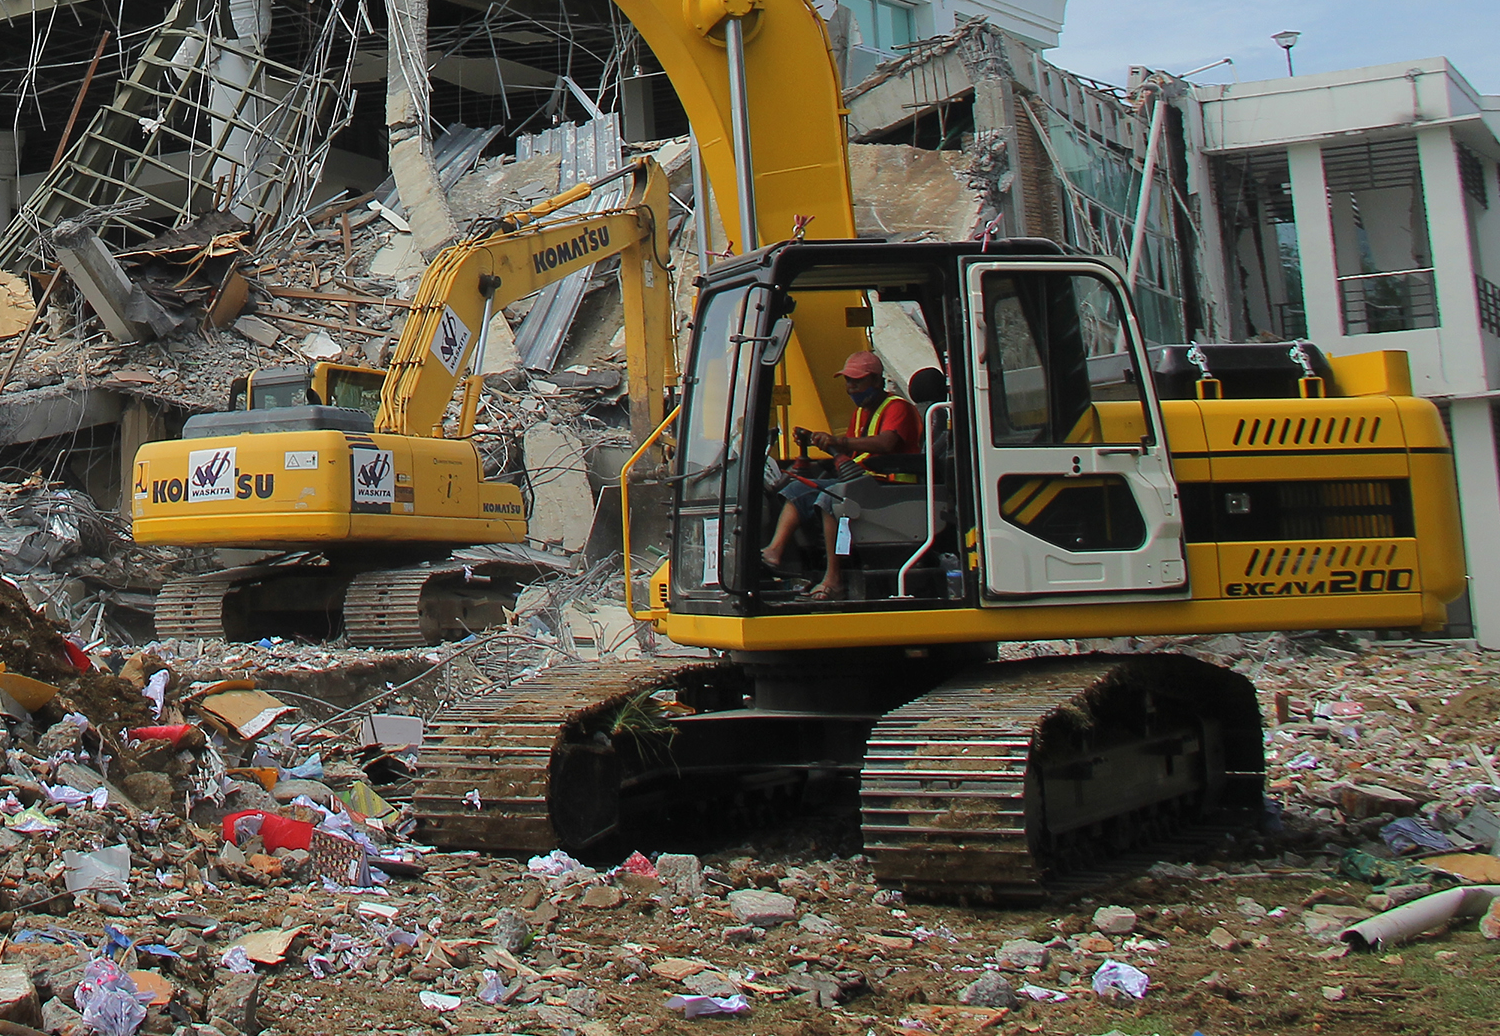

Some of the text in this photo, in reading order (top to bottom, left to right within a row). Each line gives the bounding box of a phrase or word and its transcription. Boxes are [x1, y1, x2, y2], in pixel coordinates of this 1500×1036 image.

[532, 225, 610, 274] KOMATSU
[449, 332, 468, 369] WASKITA
[152, 467, 274, 503] KOSU
[191, 487, 231, 497] WASKITA
[357, 488, 392, 498] WASKITA
[483, 502, 521, 514] KOMATSU
